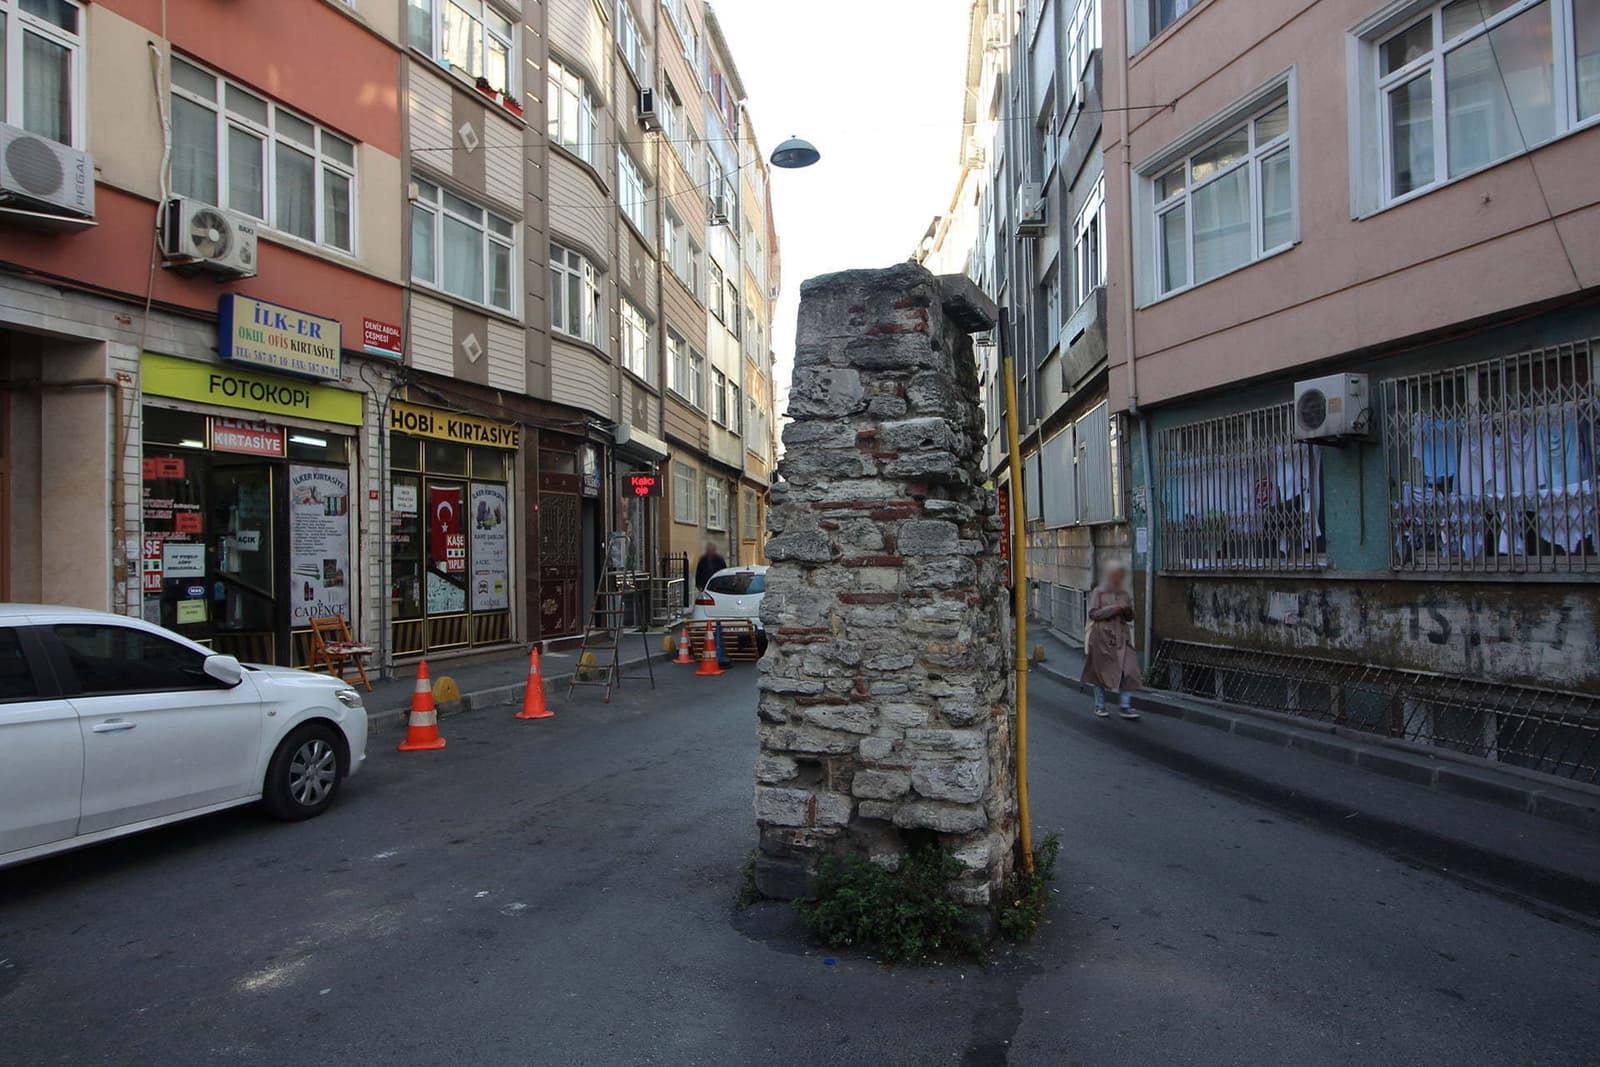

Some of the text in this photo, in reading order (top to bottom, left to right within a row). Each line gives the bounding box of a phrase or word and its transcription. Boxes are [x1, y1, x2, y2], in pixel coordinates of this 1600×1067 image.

[76, 155, 85, 206] REGAL
[254, 303, 322, 340] İLK-ER
[365, 320, 382, 332] DENİZ
[238, 326, 336, 360] OKUL OFİS KIRTASİYE
[254, 349, 266, 362] 587
[214, 431, 281, 451] KIRTASİYE
[391, 409, 434, 433] HOBİ
[448, 419, 519, 446] KIRTASİYE
[294, 604, 344, 618] CADENCE
